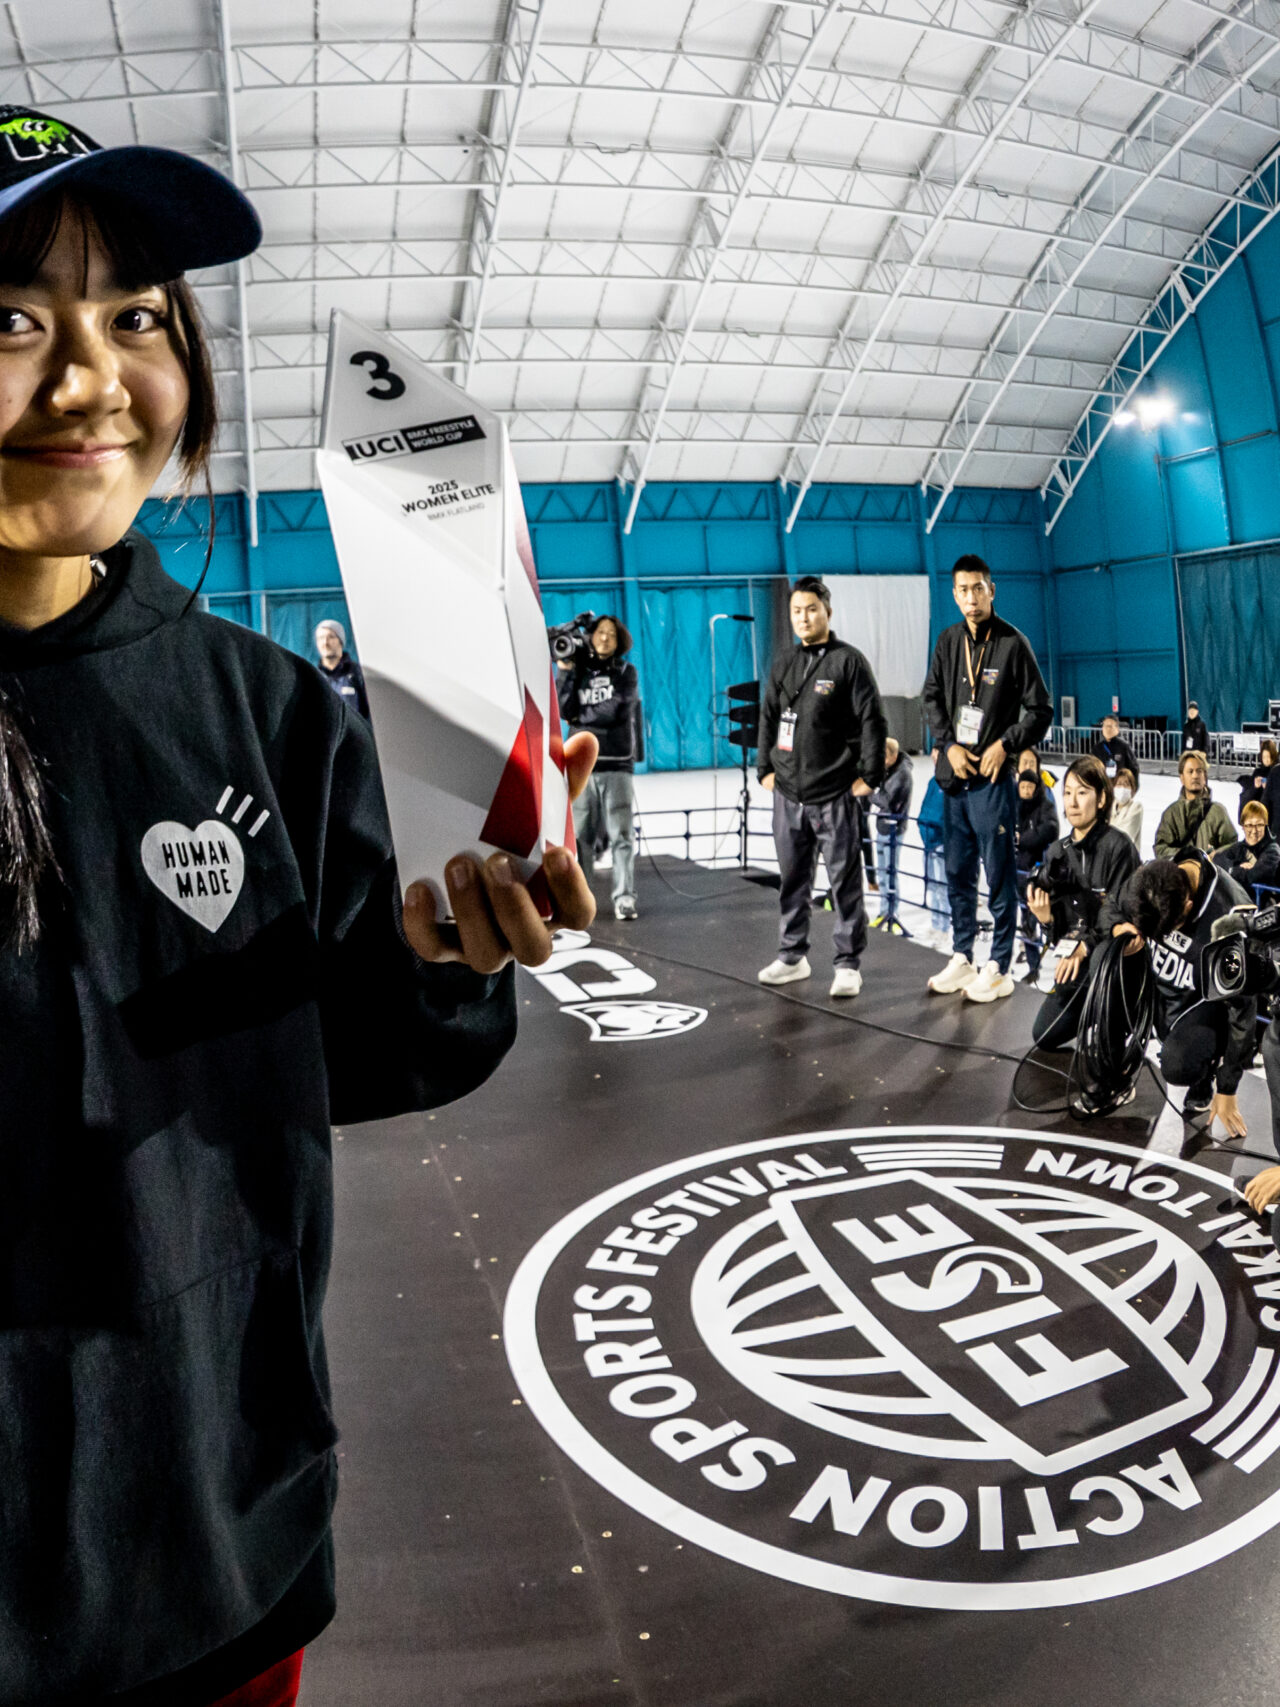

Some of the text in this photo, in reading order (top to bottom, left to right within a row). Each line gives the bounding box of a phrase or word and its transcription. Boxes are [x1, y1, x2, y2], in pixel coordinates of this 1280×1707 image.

[349, 350, 406, 401] 3
[411, 431, 464, 448] WORLD CUP
[429, 419, 475, 436] FREESTYLE
[401, 483, 496, 514] WOMEN ELITE
[428, 479, 459, 495] 2025
[577, 684, 615, 705] MEDI
[161, 840, 231, 869] HUMAN
[175, 868, 233, 899] MADE
[1024, 1148, 1212, 1219] TOWN
[831, 1202, 1131, 1407] FISE
[573, 1151, 1204, 1551] ACTION SPORTS FESTIVAL
